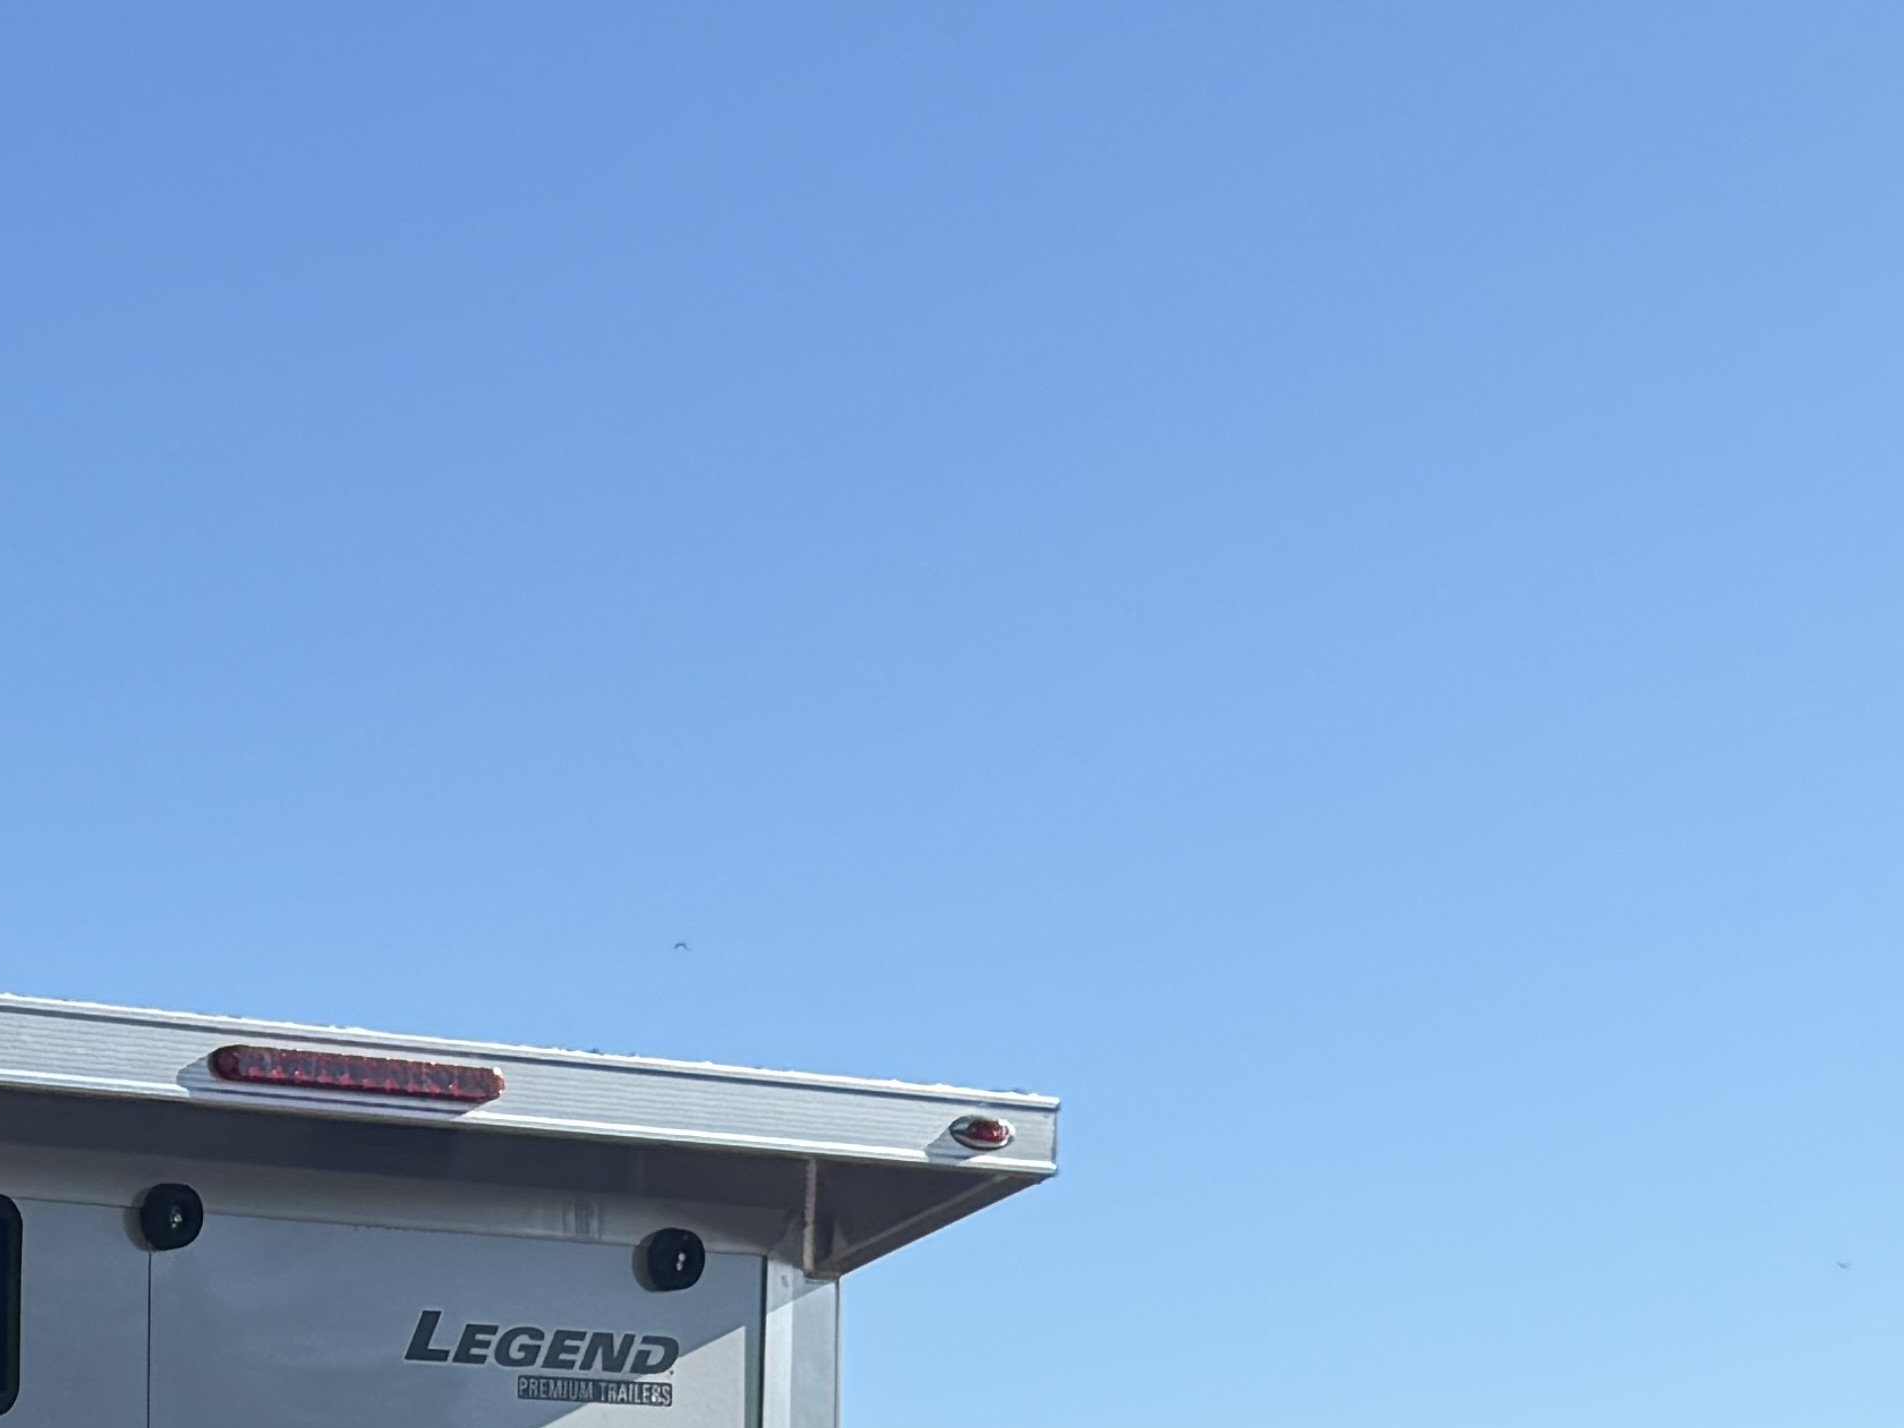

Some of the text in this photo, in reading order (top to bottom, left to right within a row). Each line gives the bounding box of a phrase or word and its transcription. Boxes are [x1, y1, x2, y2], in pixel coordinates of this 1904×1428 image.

[404, 1310, 680, 1375] LEGEND
[518, 1376, 672, 1406] PREMIUM TRAILERS
